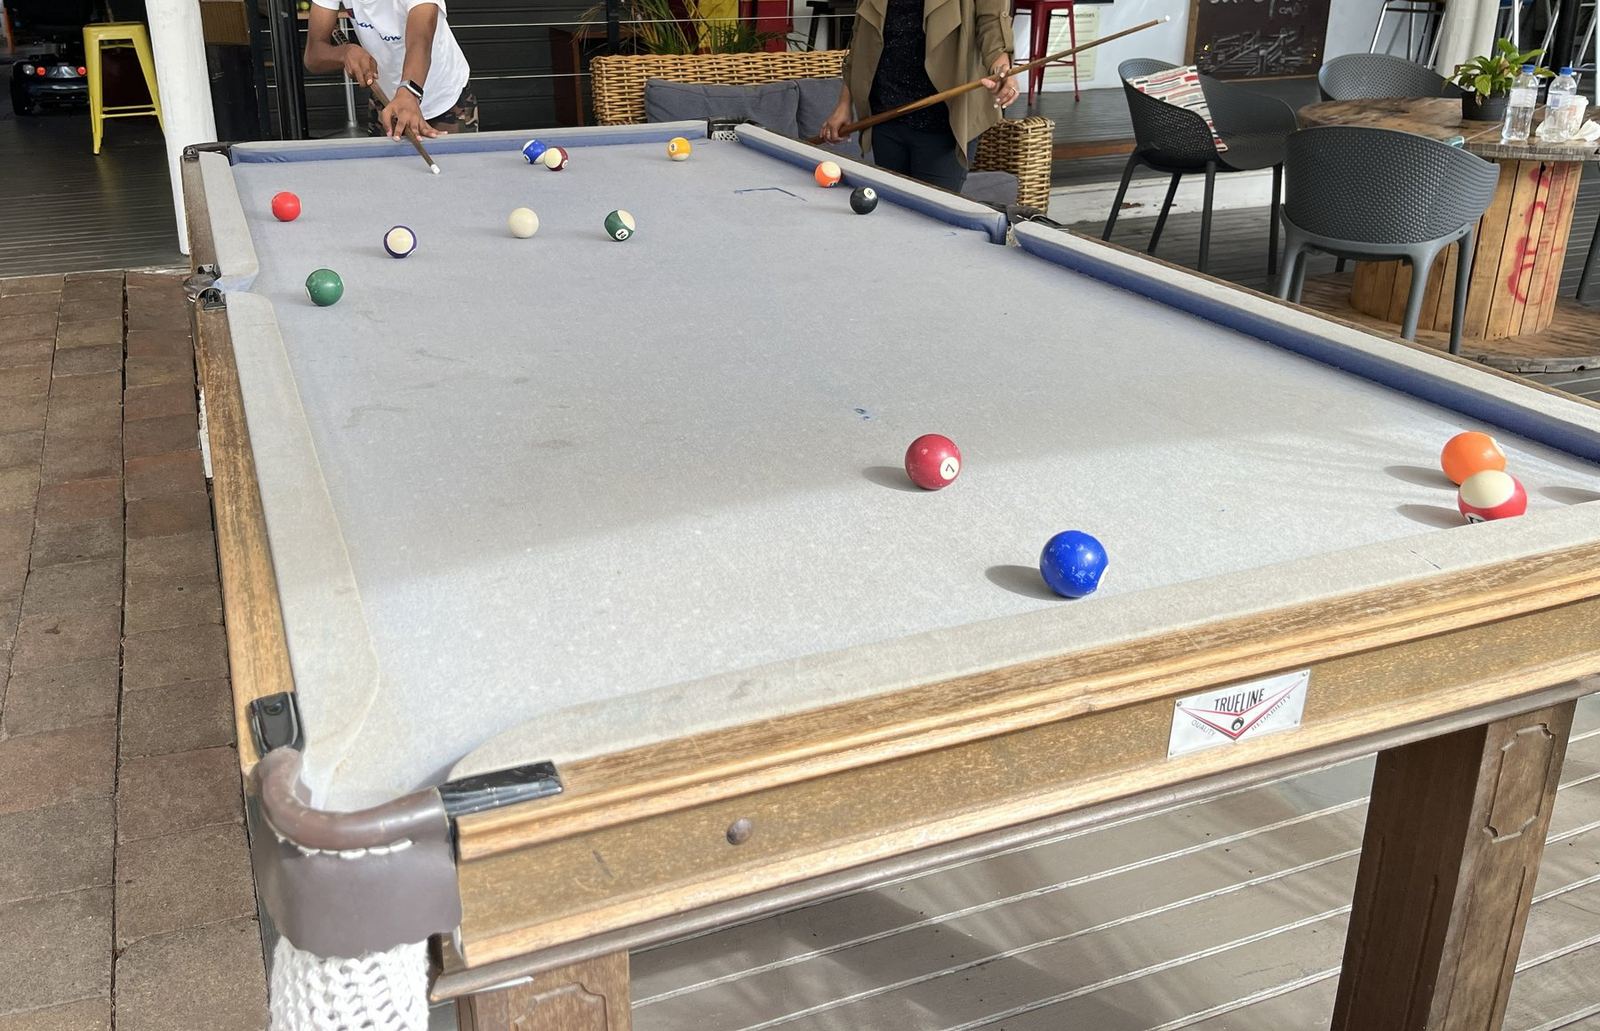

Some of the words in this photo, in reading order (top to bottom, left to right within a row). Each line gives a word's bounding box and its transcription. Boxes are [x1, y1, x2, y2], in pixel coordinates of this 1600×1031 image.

[945, 463, 955, 473] 7
[1214, 688, 1265, 713] TRUELINE
[1191, 719, 1217, 737] QUALITY
